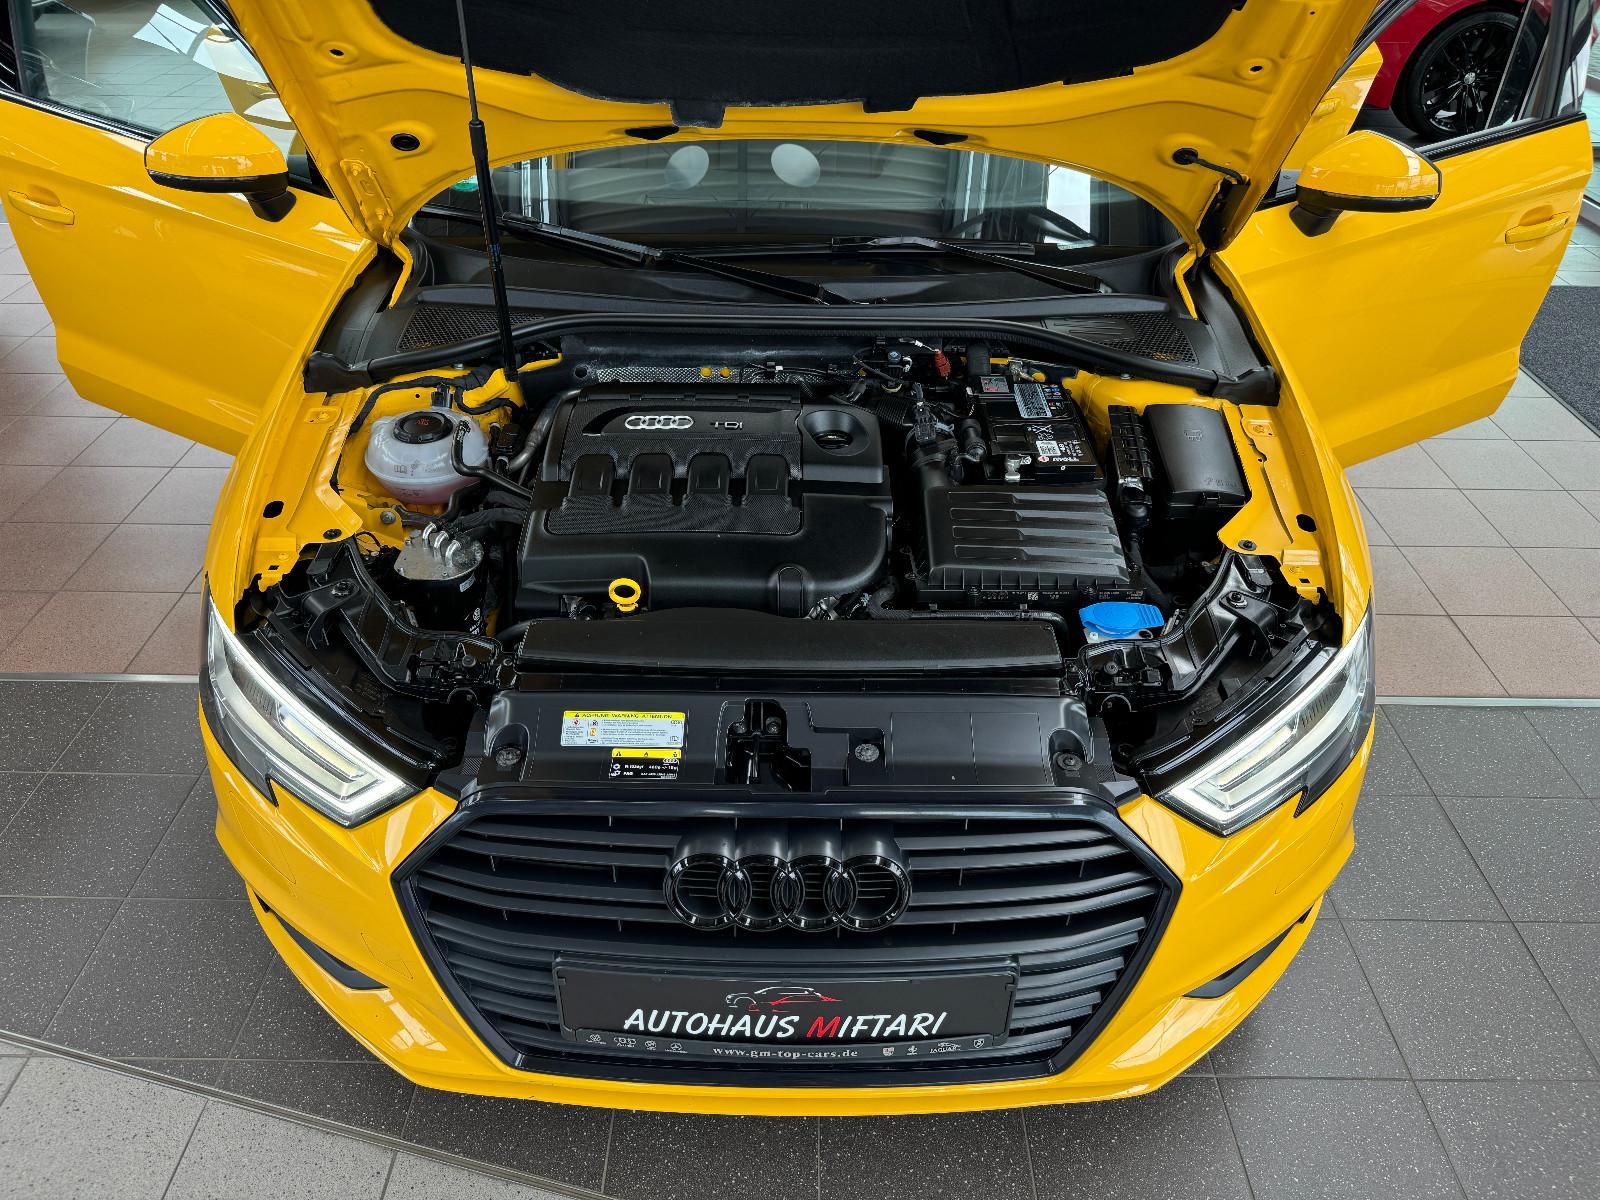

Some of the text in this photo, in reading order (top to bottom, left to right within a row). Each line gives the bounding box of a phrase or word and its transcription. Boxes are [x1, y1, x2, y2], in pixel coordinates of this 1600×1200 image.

[624, 1008, 947, 1038] AUTOHAUS MIFTARI
[713, 1047, 858, 1059] www.gm-top-cars.de
